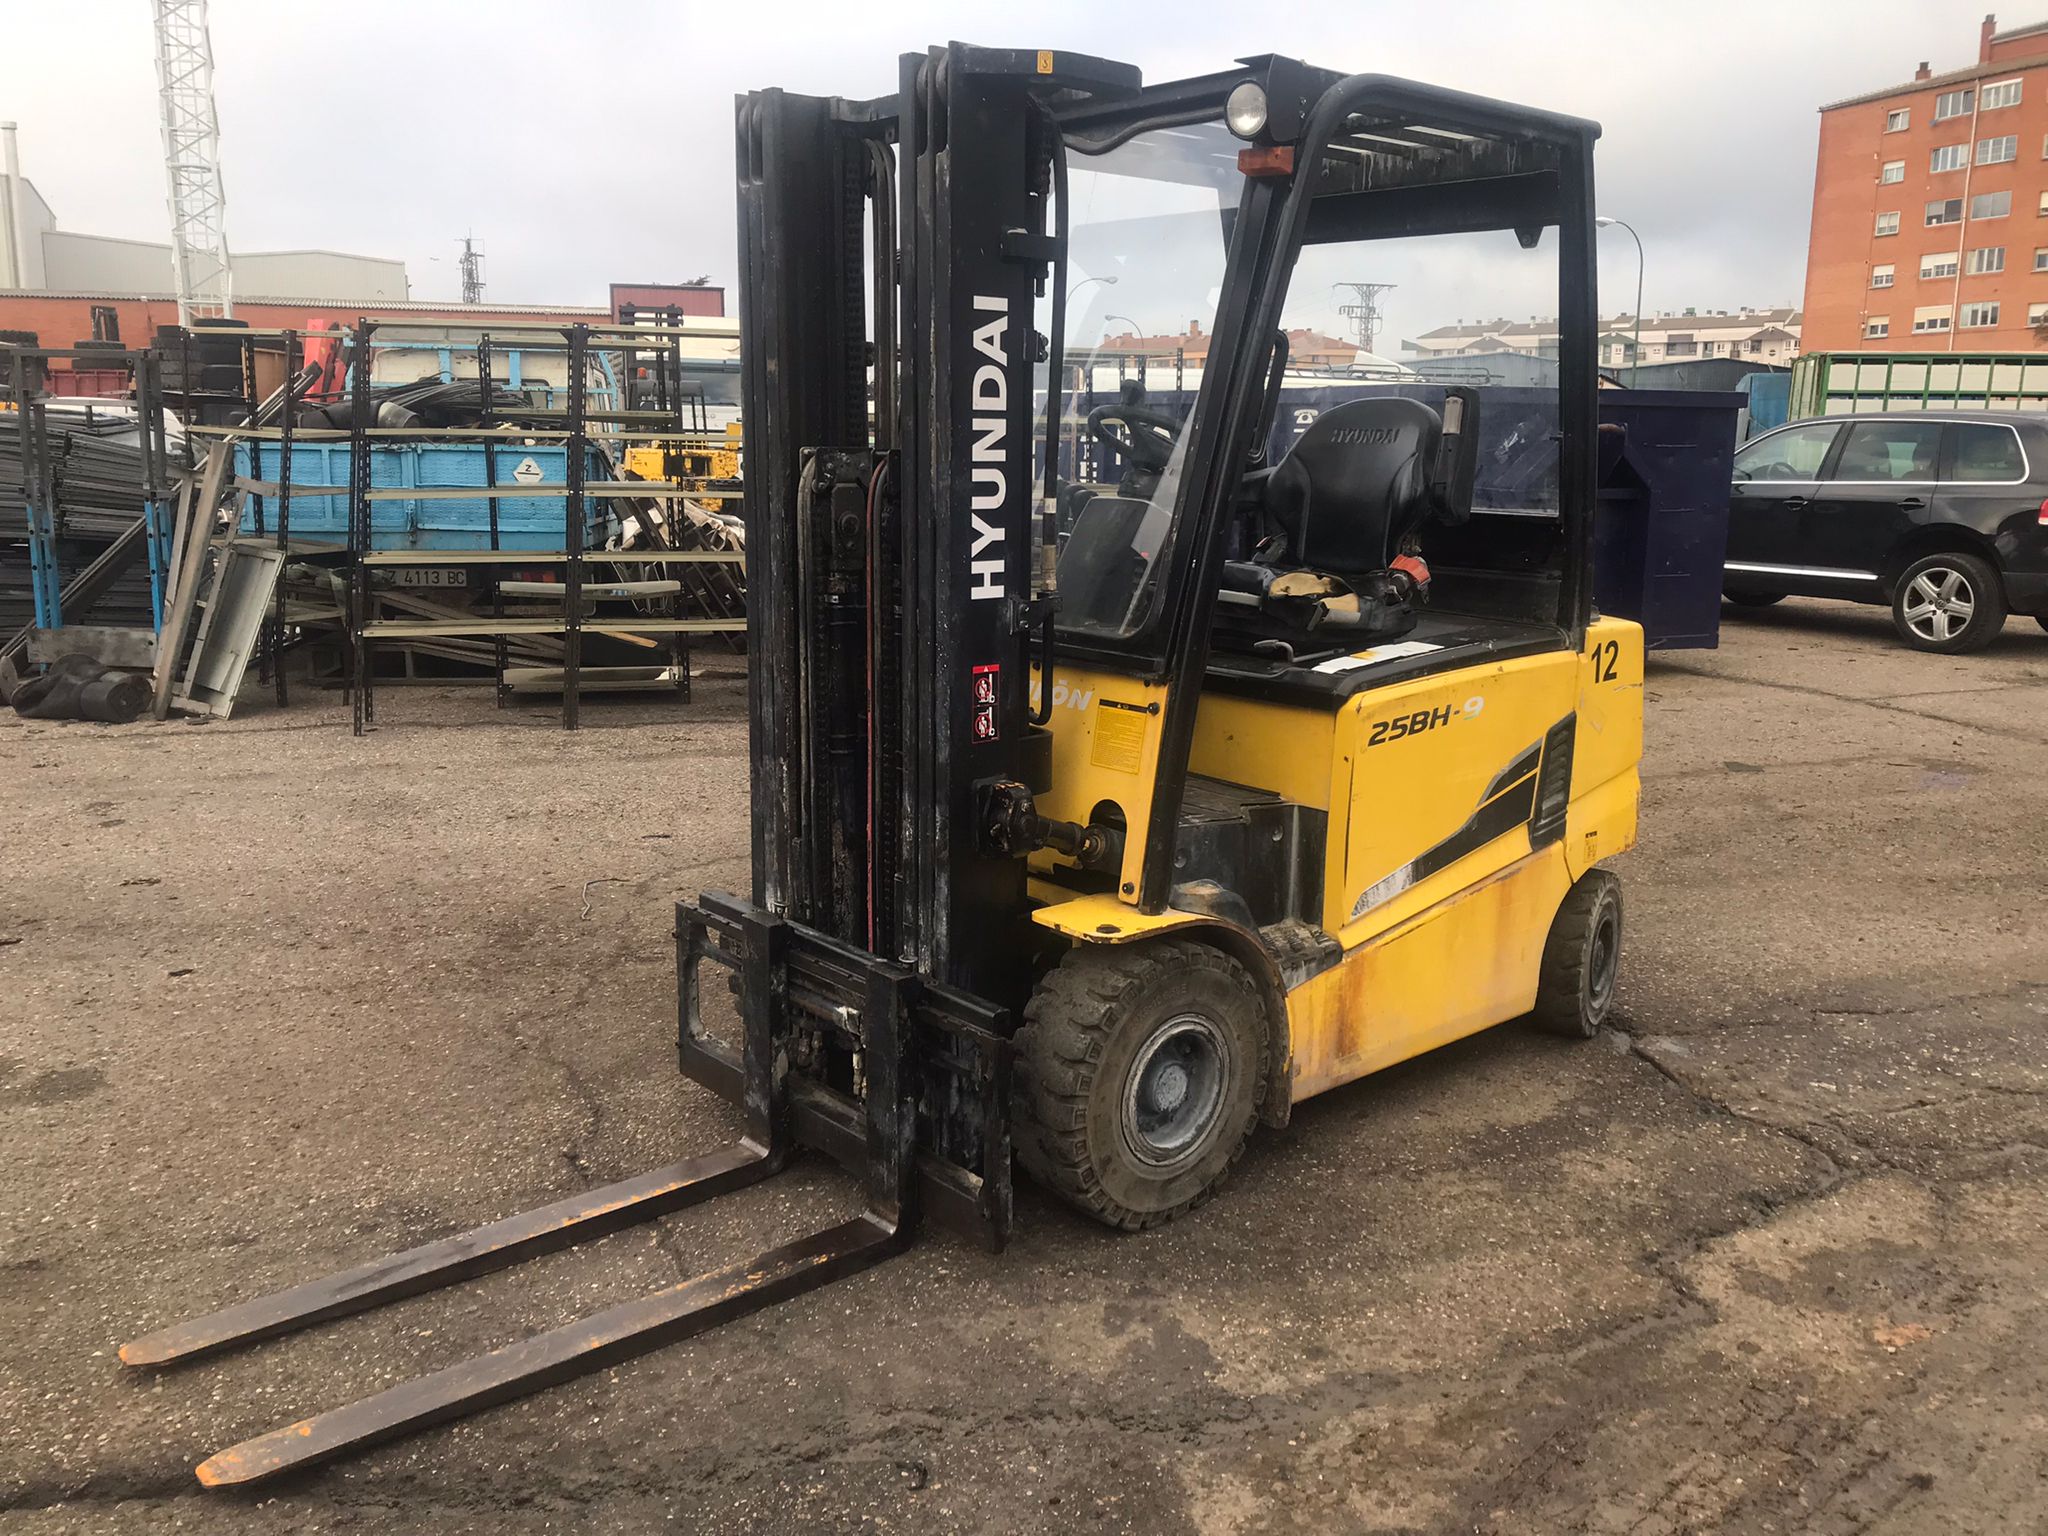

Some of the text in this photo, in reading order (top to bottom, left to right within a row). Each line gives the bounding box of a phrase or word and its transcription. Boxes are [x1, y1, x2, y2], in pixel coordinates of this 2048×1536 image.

[971, 295, 1009, 600] HYUNDAI
[1331, 428, 1400, 444] HYUNDAI
[404, 570, 440, 585] 4113
[447, 570, 465, 585] BC
[1591, 640, 1619, 684] 12
[1367, 695, 1485, 747] 25BH-9
